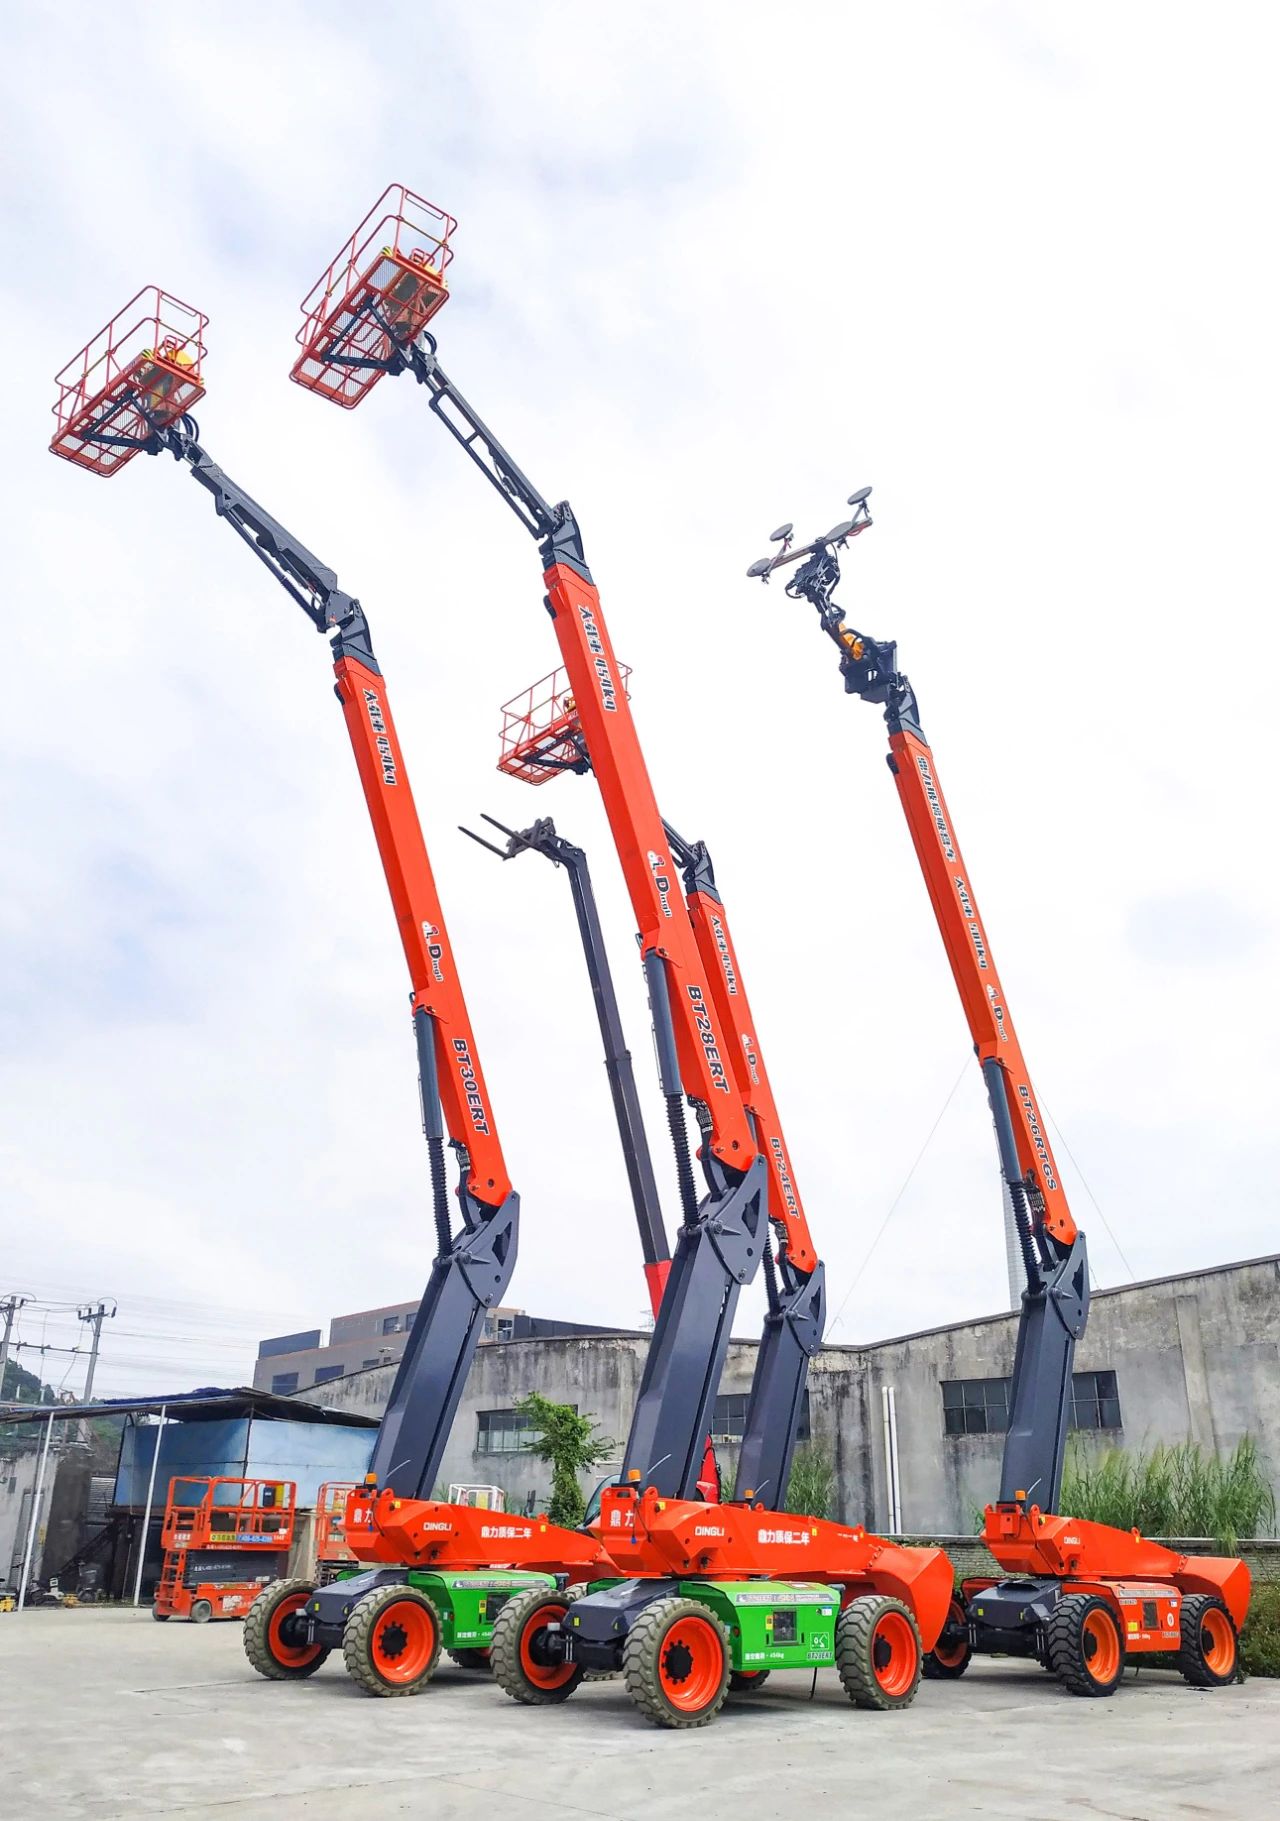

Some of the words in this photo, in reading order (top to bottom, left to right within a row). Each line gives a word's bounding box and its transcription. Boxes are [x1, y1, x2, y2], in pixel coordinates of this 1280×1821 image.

[687, 985, 729, 1094] BT28ERT
[452, 1038, 490, 1135] BT30ERT
[1018, 1085, 1058, 1190] BT26RTGS
[770, 1137, 800, 1218] BT24ERT
[423, 1522, 452, 1531] DINGLI
[610, 1509, 634, 1528] 鼎力
[694, 1526, 725, 1537] DINGLI
[757, 1529, 811, 1545] 鼎力质保二年
